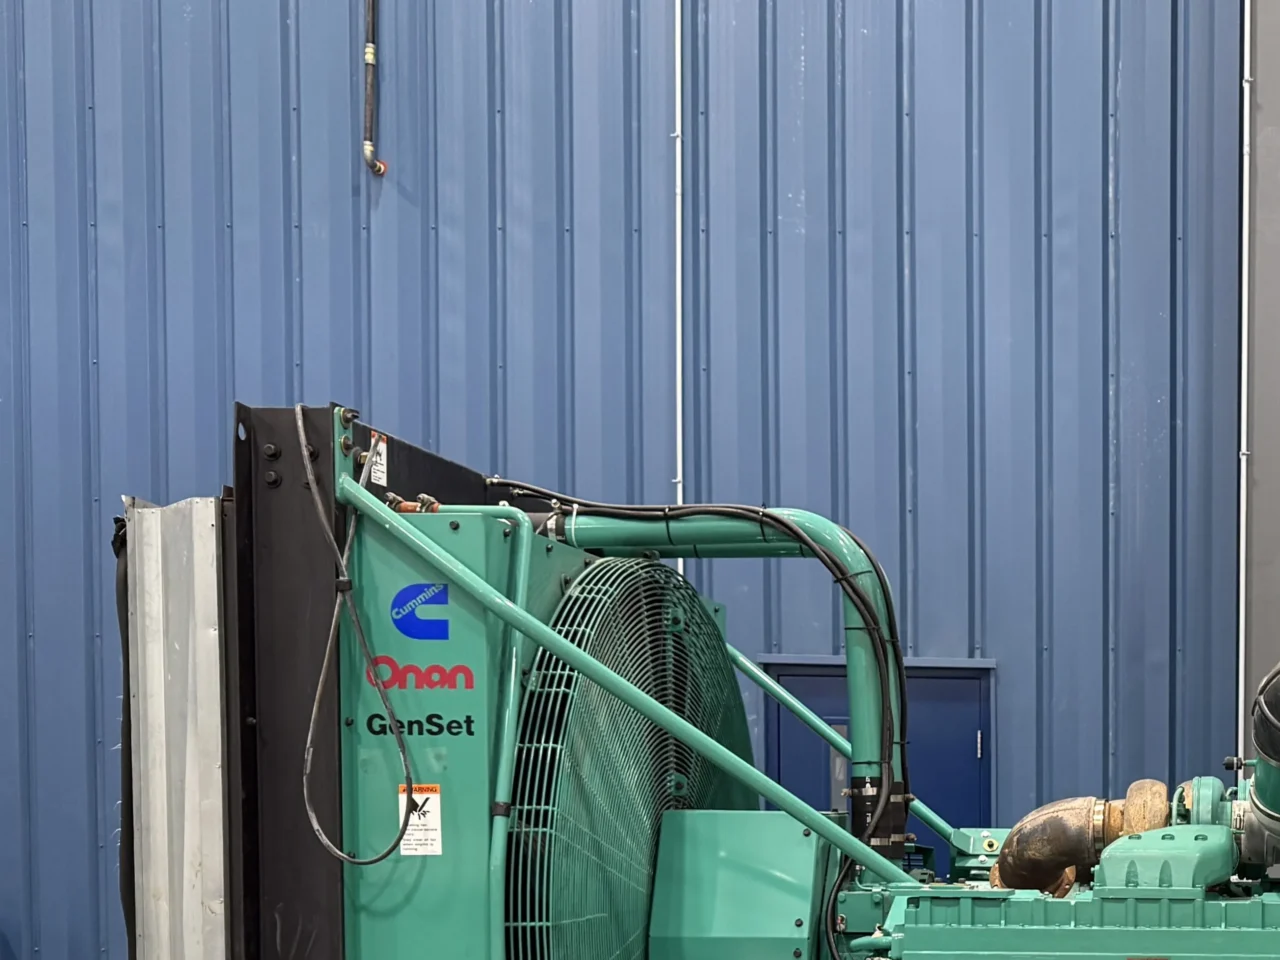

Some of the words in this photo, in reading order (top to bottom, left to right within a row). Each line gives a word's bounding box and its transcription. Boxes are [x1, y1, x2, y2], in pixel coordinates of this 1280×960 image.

[391, 583, 444, 620] Cummins
[366, 655, 474, 690] Onan
[366, 713, 475, 737] GenSet
